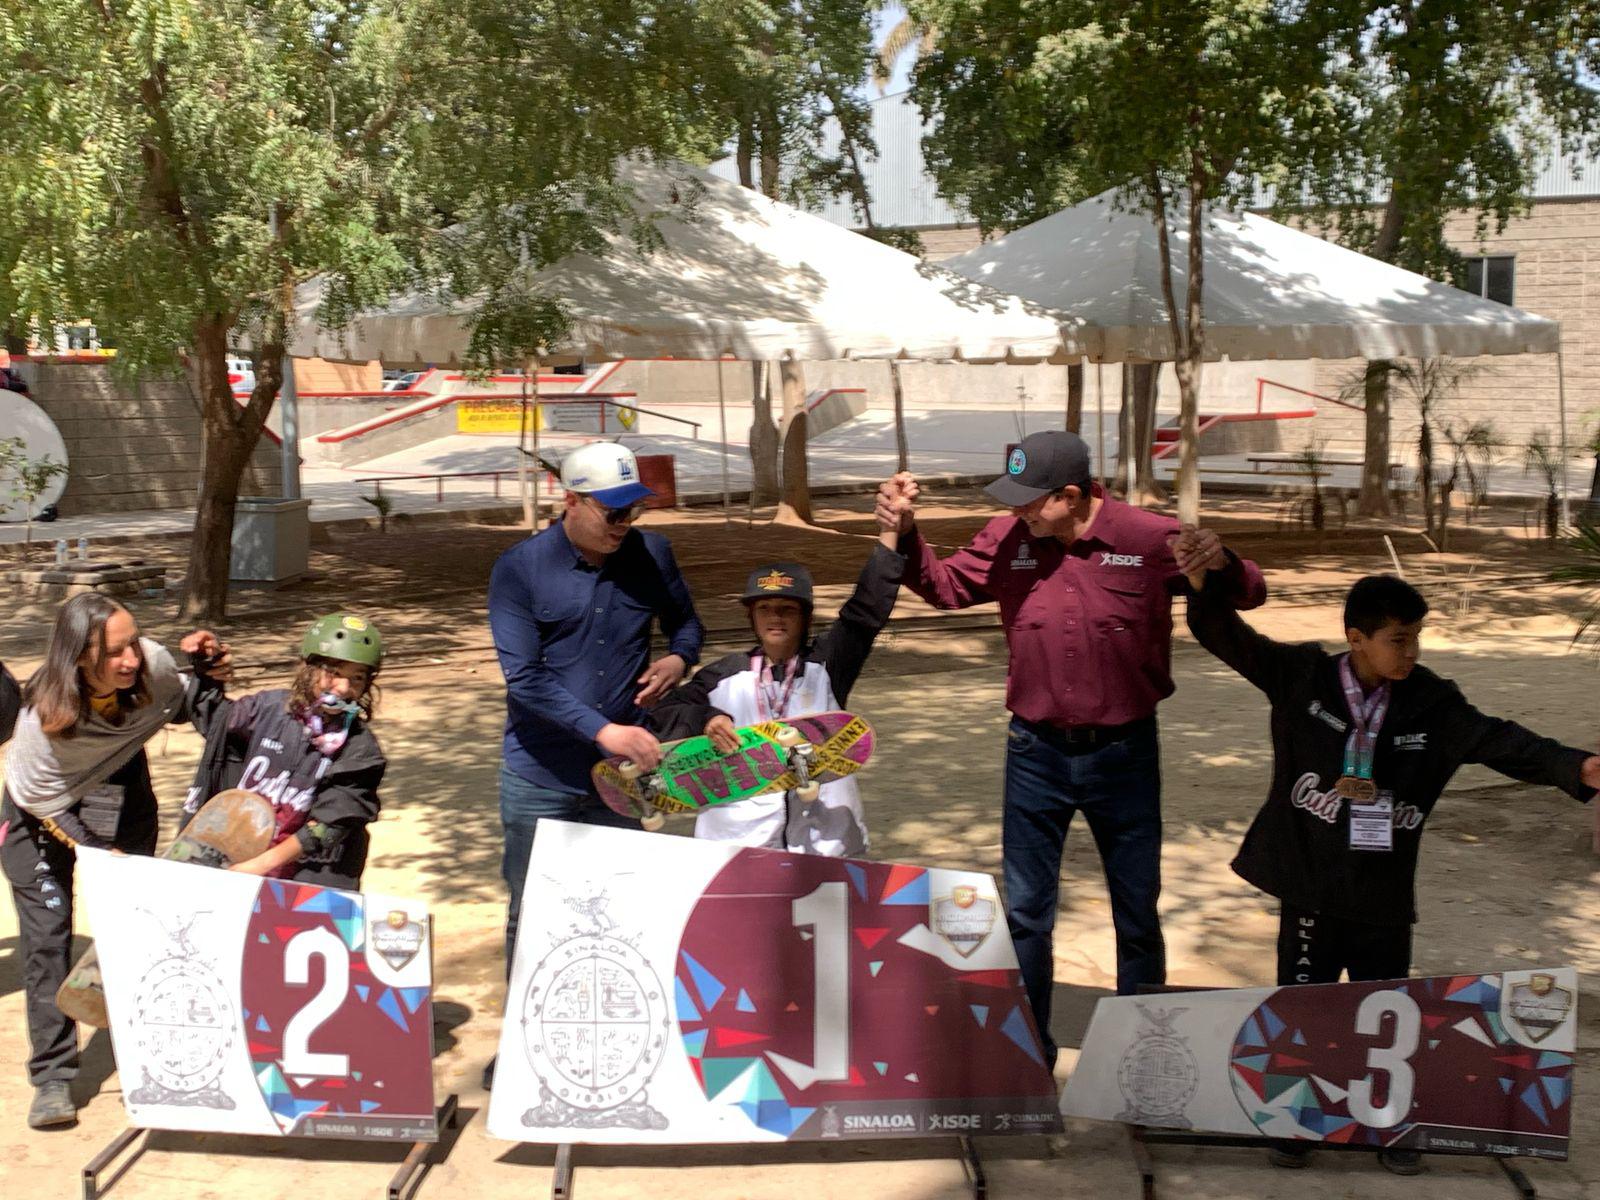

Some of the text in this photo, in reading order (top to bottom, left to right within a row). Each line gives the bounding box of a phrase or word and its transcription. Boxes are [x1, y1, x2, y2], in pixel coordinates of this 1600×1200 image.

[673, 743, 786, 806] REAL
[282, 926, 349, 1077] 2
[564, 944, 627, 958] SINALOA
[792, 882, 849, 1081] 1
[1347, 990, 1422, 1129] 3
[843, 1114, 916, 1129] SINALOA
